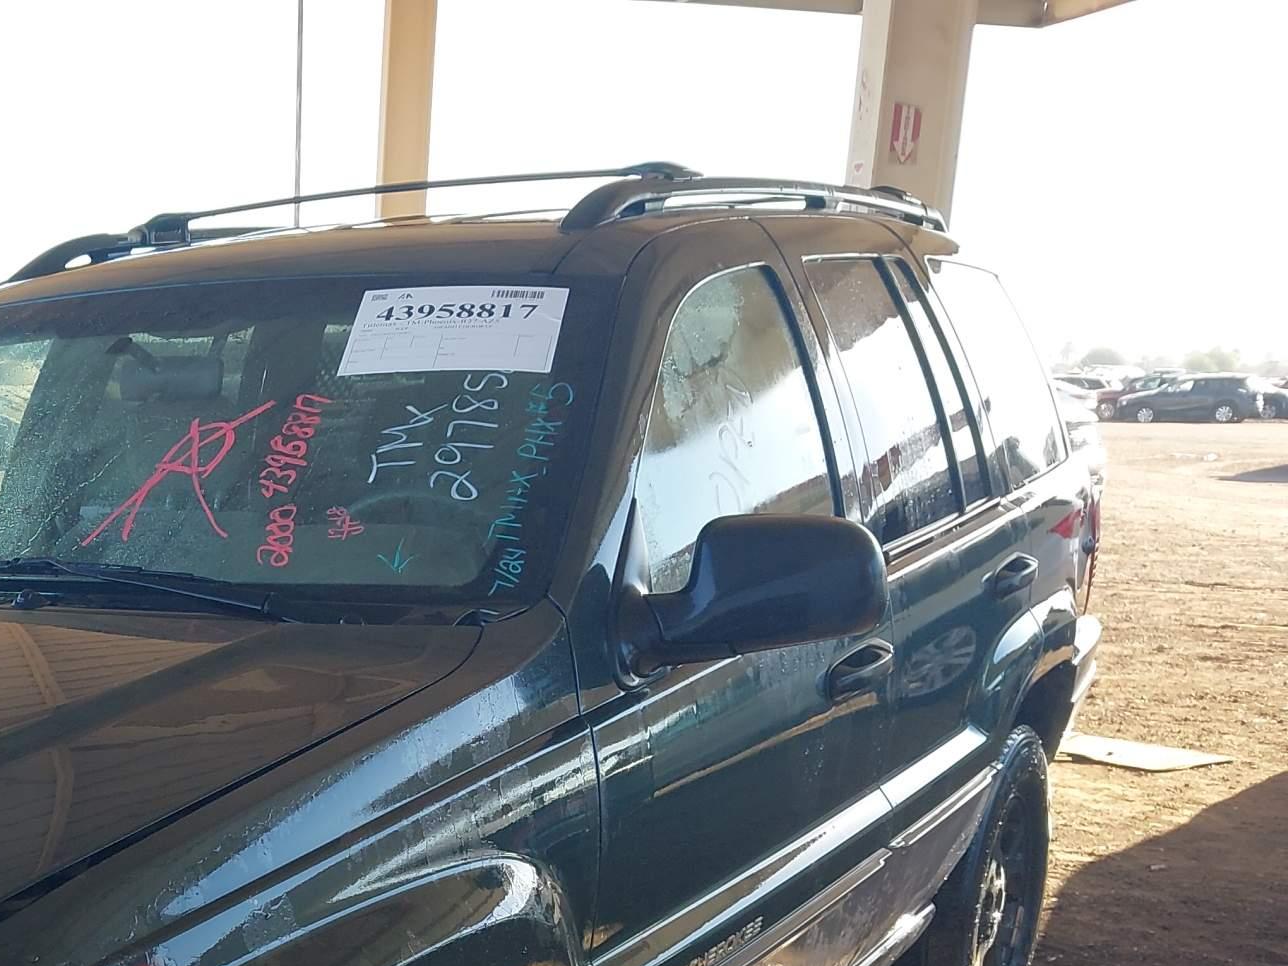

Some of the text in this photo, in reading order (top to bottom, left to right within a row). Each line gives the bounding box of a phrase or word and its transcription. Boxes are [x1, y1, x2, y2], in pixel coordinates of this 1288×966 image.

[376, 302, 538, 321] 43958817
[429, 370, 511, 501] 29785
[256, 503, 297, 568] 2000
